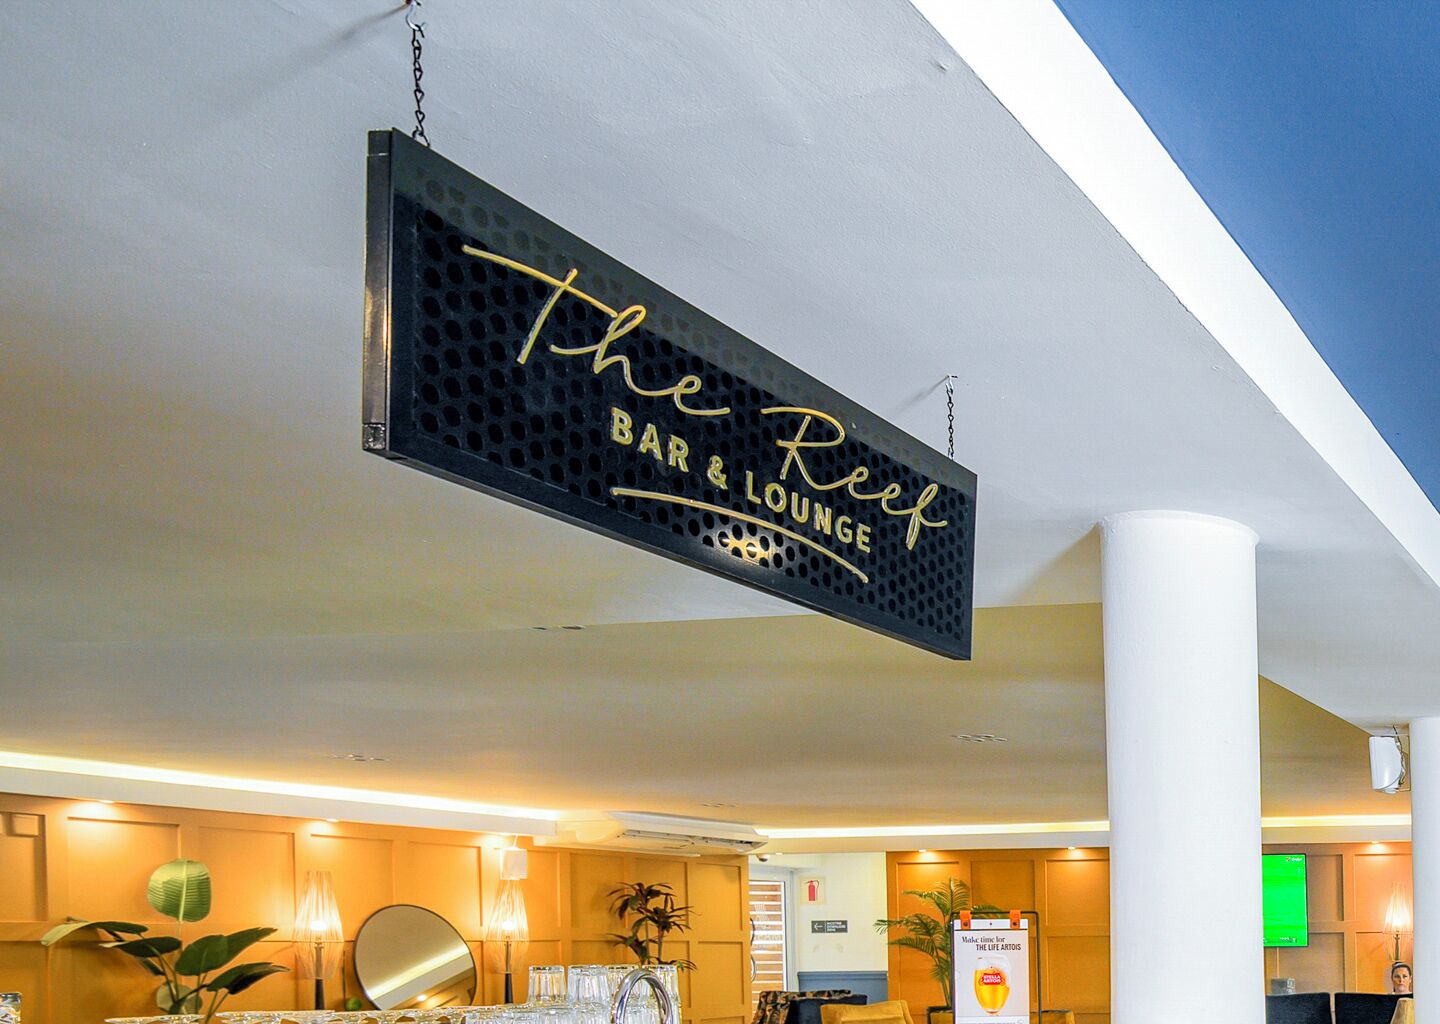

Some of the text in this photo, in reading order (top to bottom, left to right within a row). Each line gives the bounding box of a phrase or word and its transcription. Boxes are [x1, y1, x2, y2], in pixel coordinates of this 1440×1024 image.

[462, 245, 948, 550] The Reef
[610, 407, 872, 554] BAR & LOUNGE
